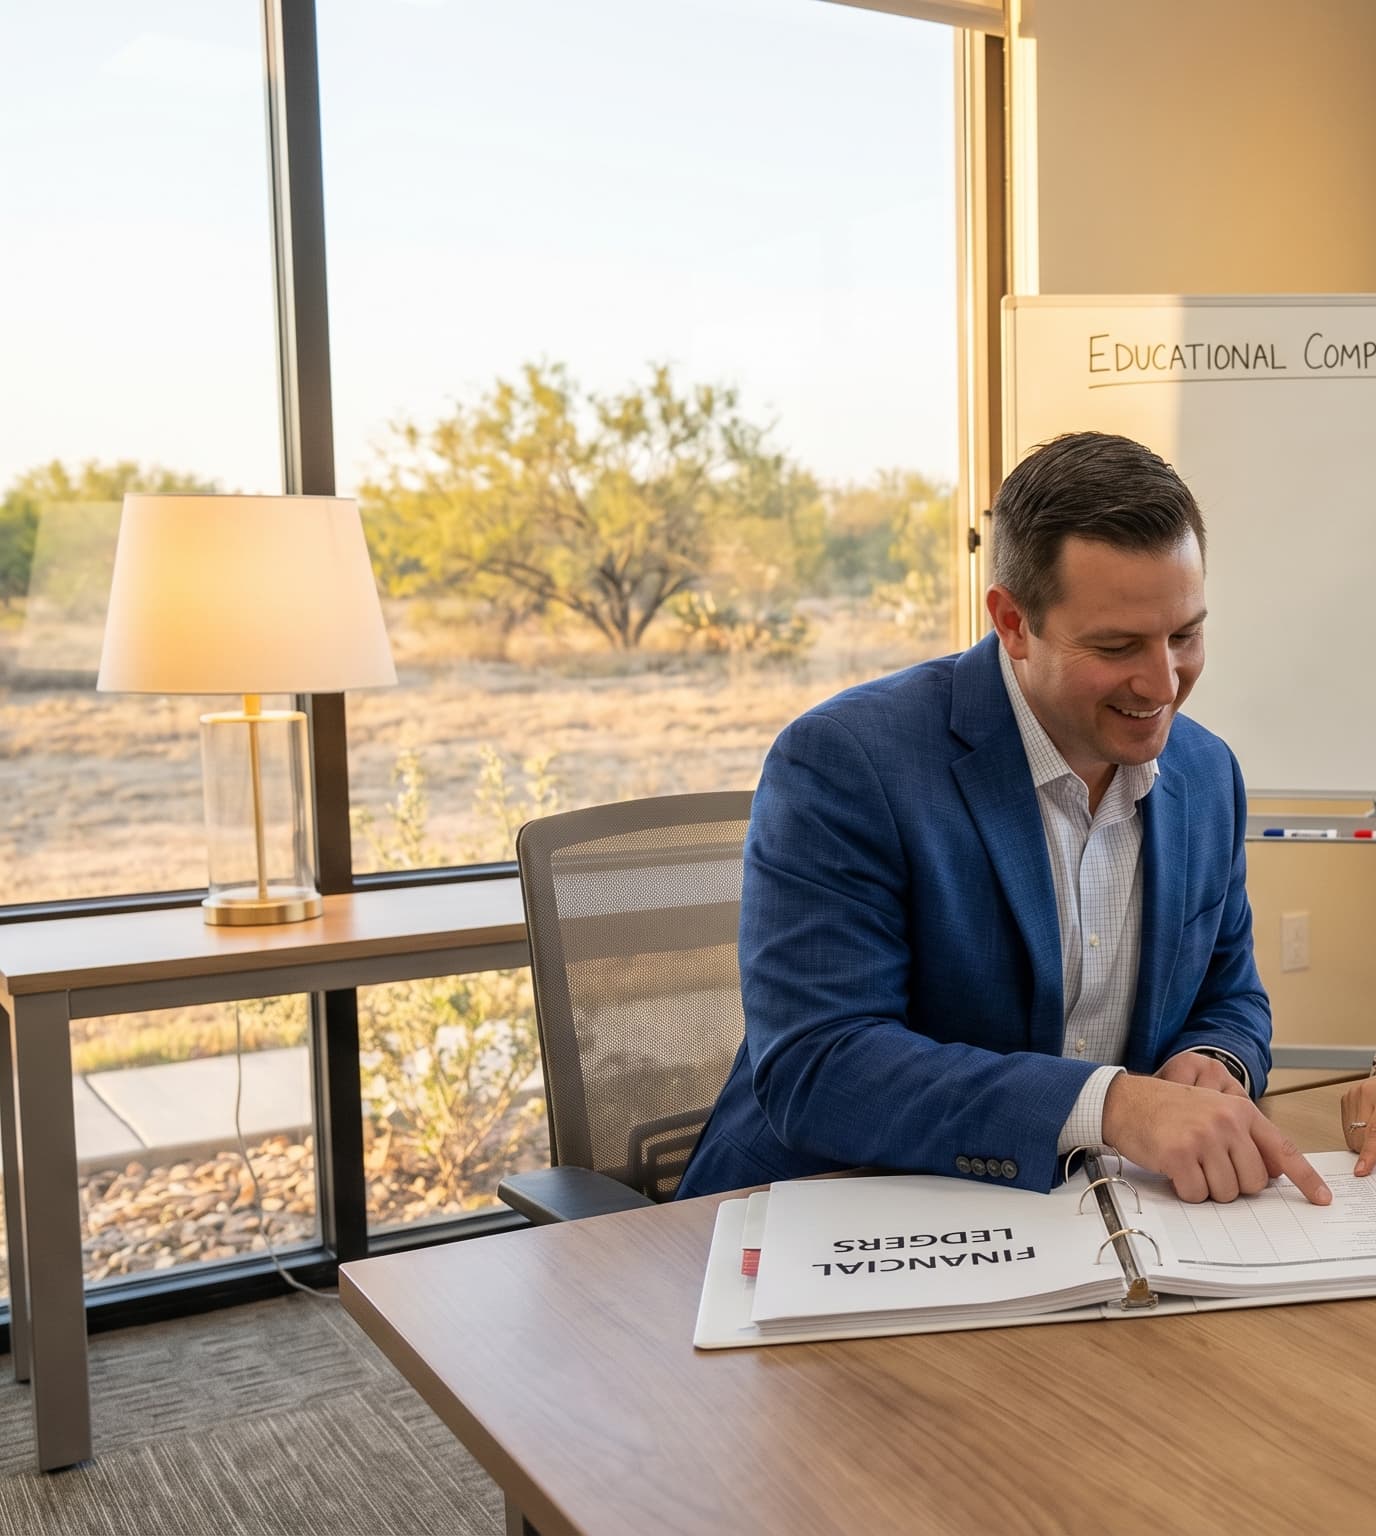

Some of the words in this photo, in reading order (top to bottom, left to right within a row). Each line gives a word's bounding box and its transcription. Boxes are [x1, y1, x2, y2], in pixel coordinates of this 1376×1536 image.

[1088, 333, 1287, 373] EDUCATIONAL
[833, 1227, 1014, 1253] LEDGERS
[811, 1245, 1036, 1277] FINANCIAL
